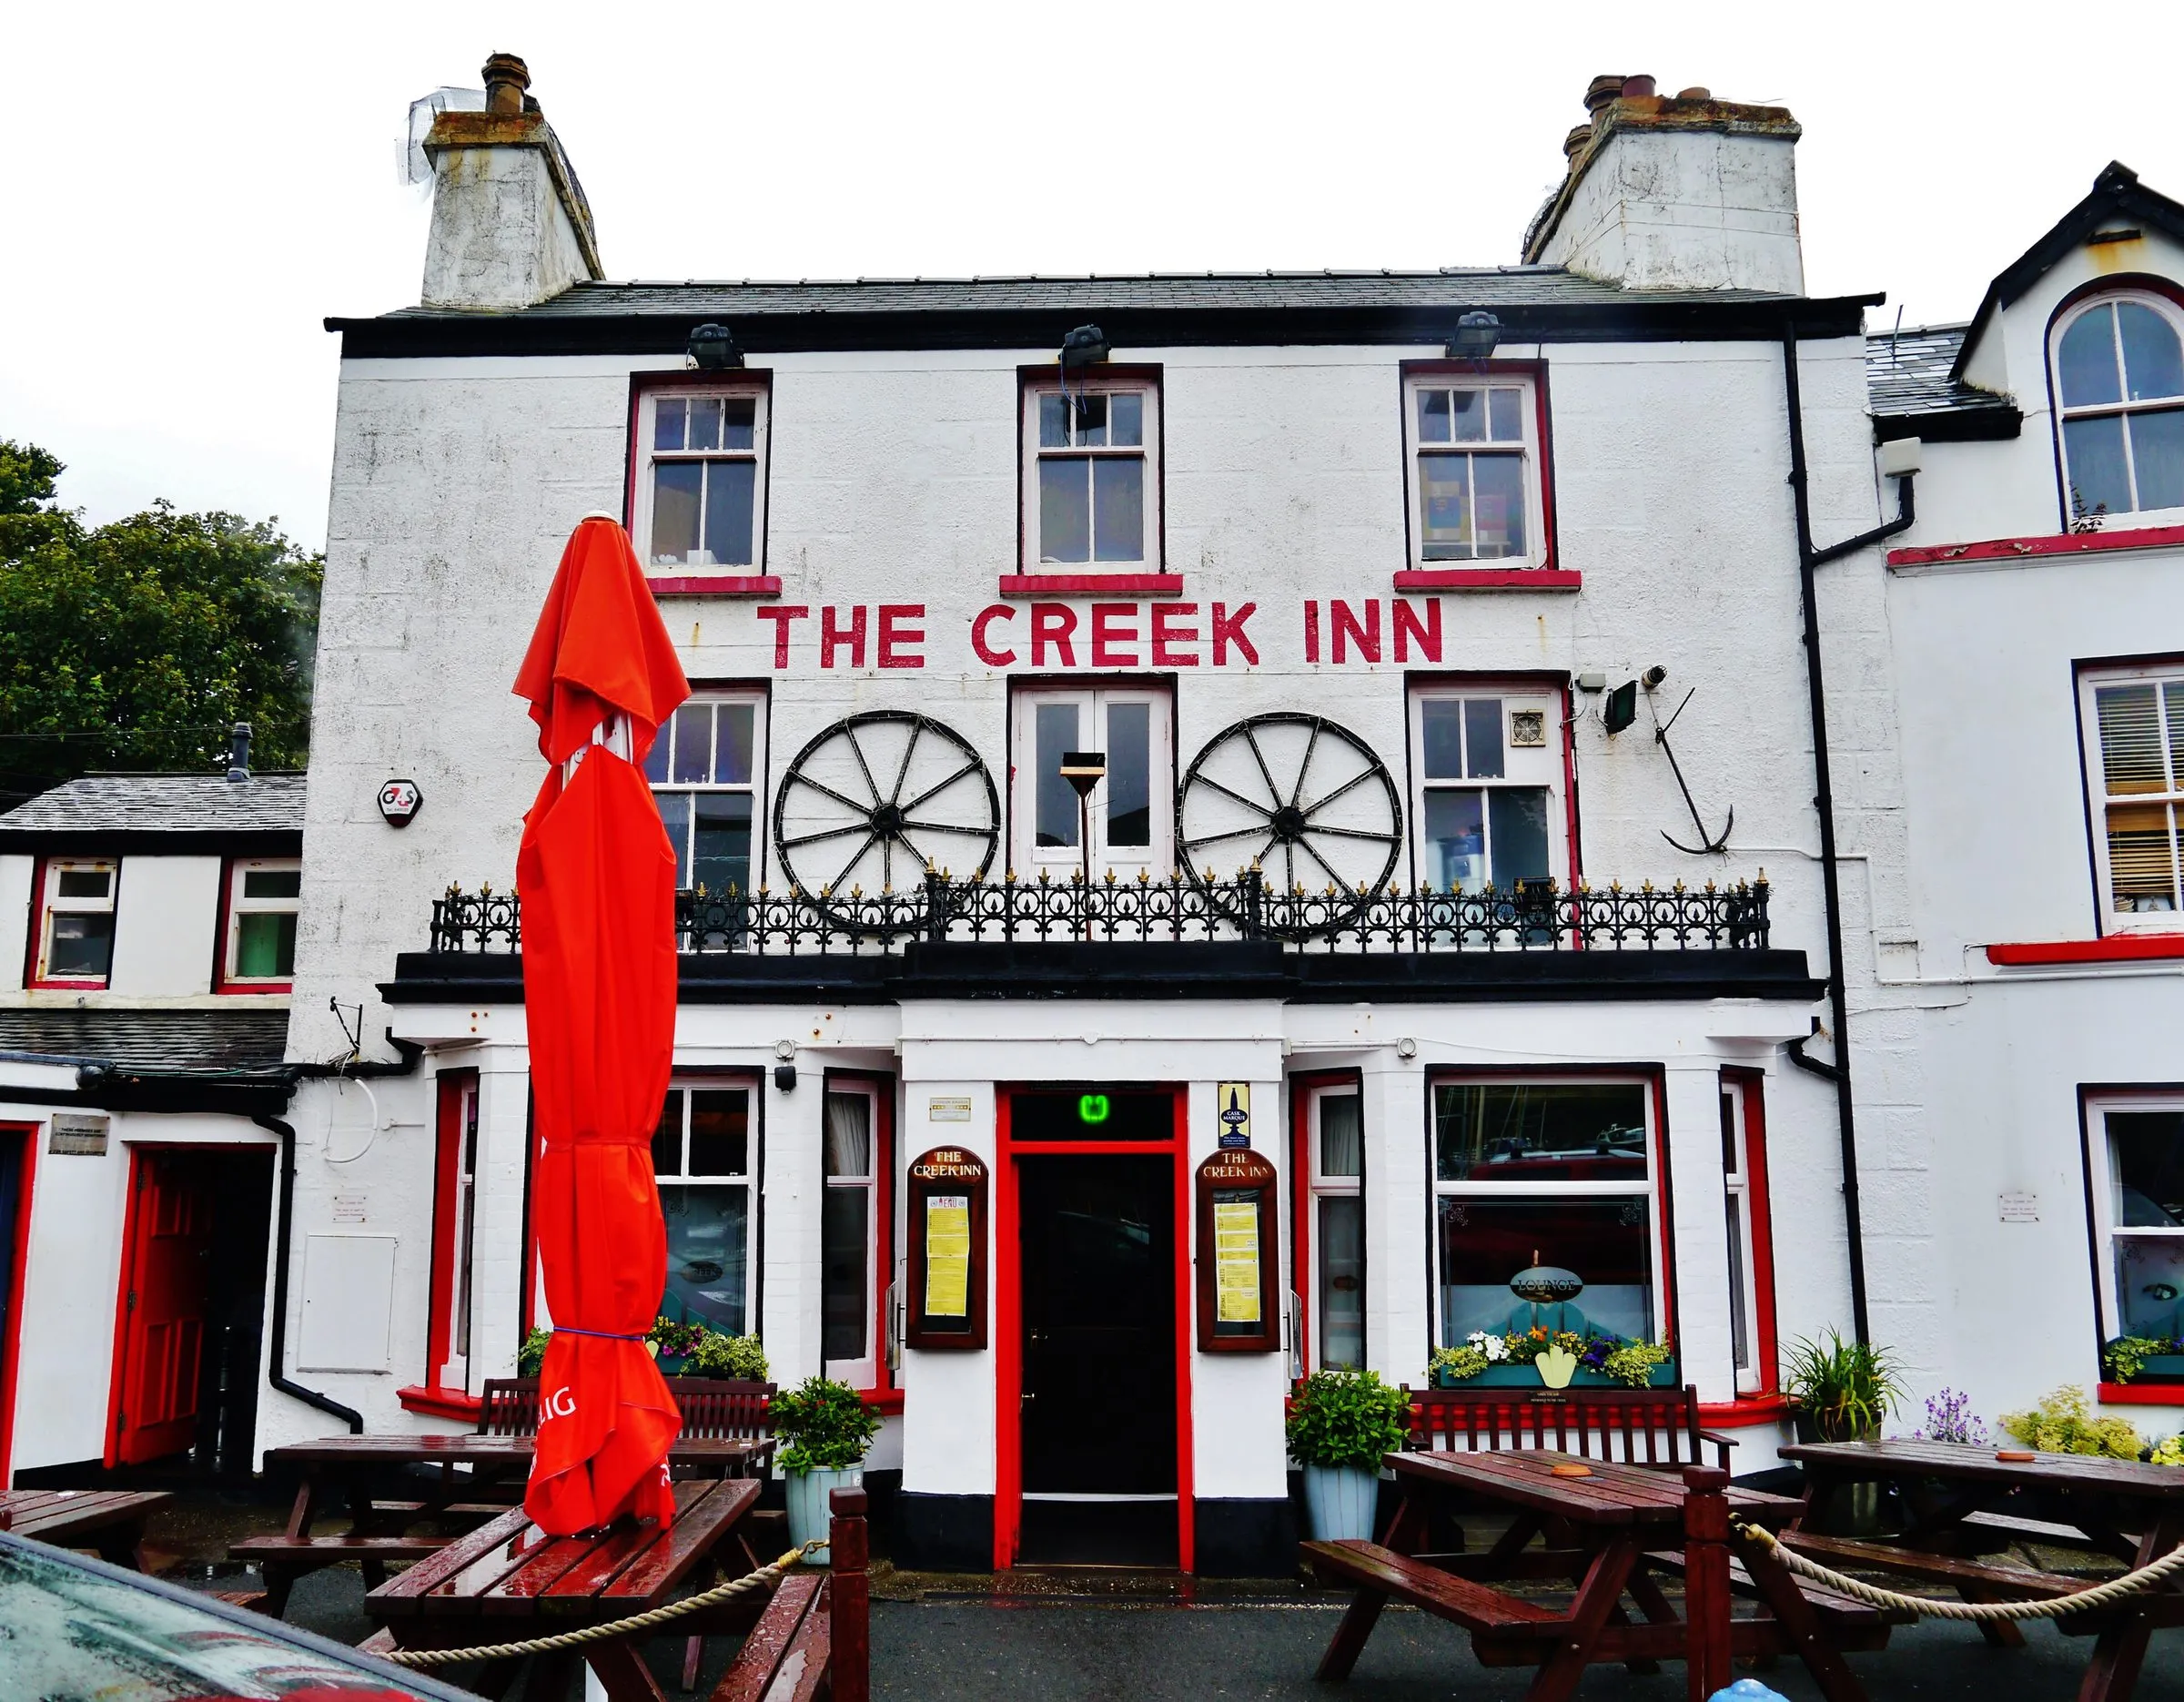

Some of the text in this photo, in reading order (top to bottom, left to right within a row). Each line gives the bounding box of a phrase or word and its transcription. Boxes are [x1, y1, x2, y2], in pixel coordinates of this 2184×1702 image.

[757, 598, 1442, 669] THE CREEK INN
[382, 787, 414, 806] G4S
[935, 1151, 962, 1162] THE
[1222, 1152, 1249, 1163] THE
[914, 1164, 981, 1179] CREEK INN
[1203, 1166, 1246, 1178] CREEK
[1518, 1279, 1575, 1291] LOUNGE
